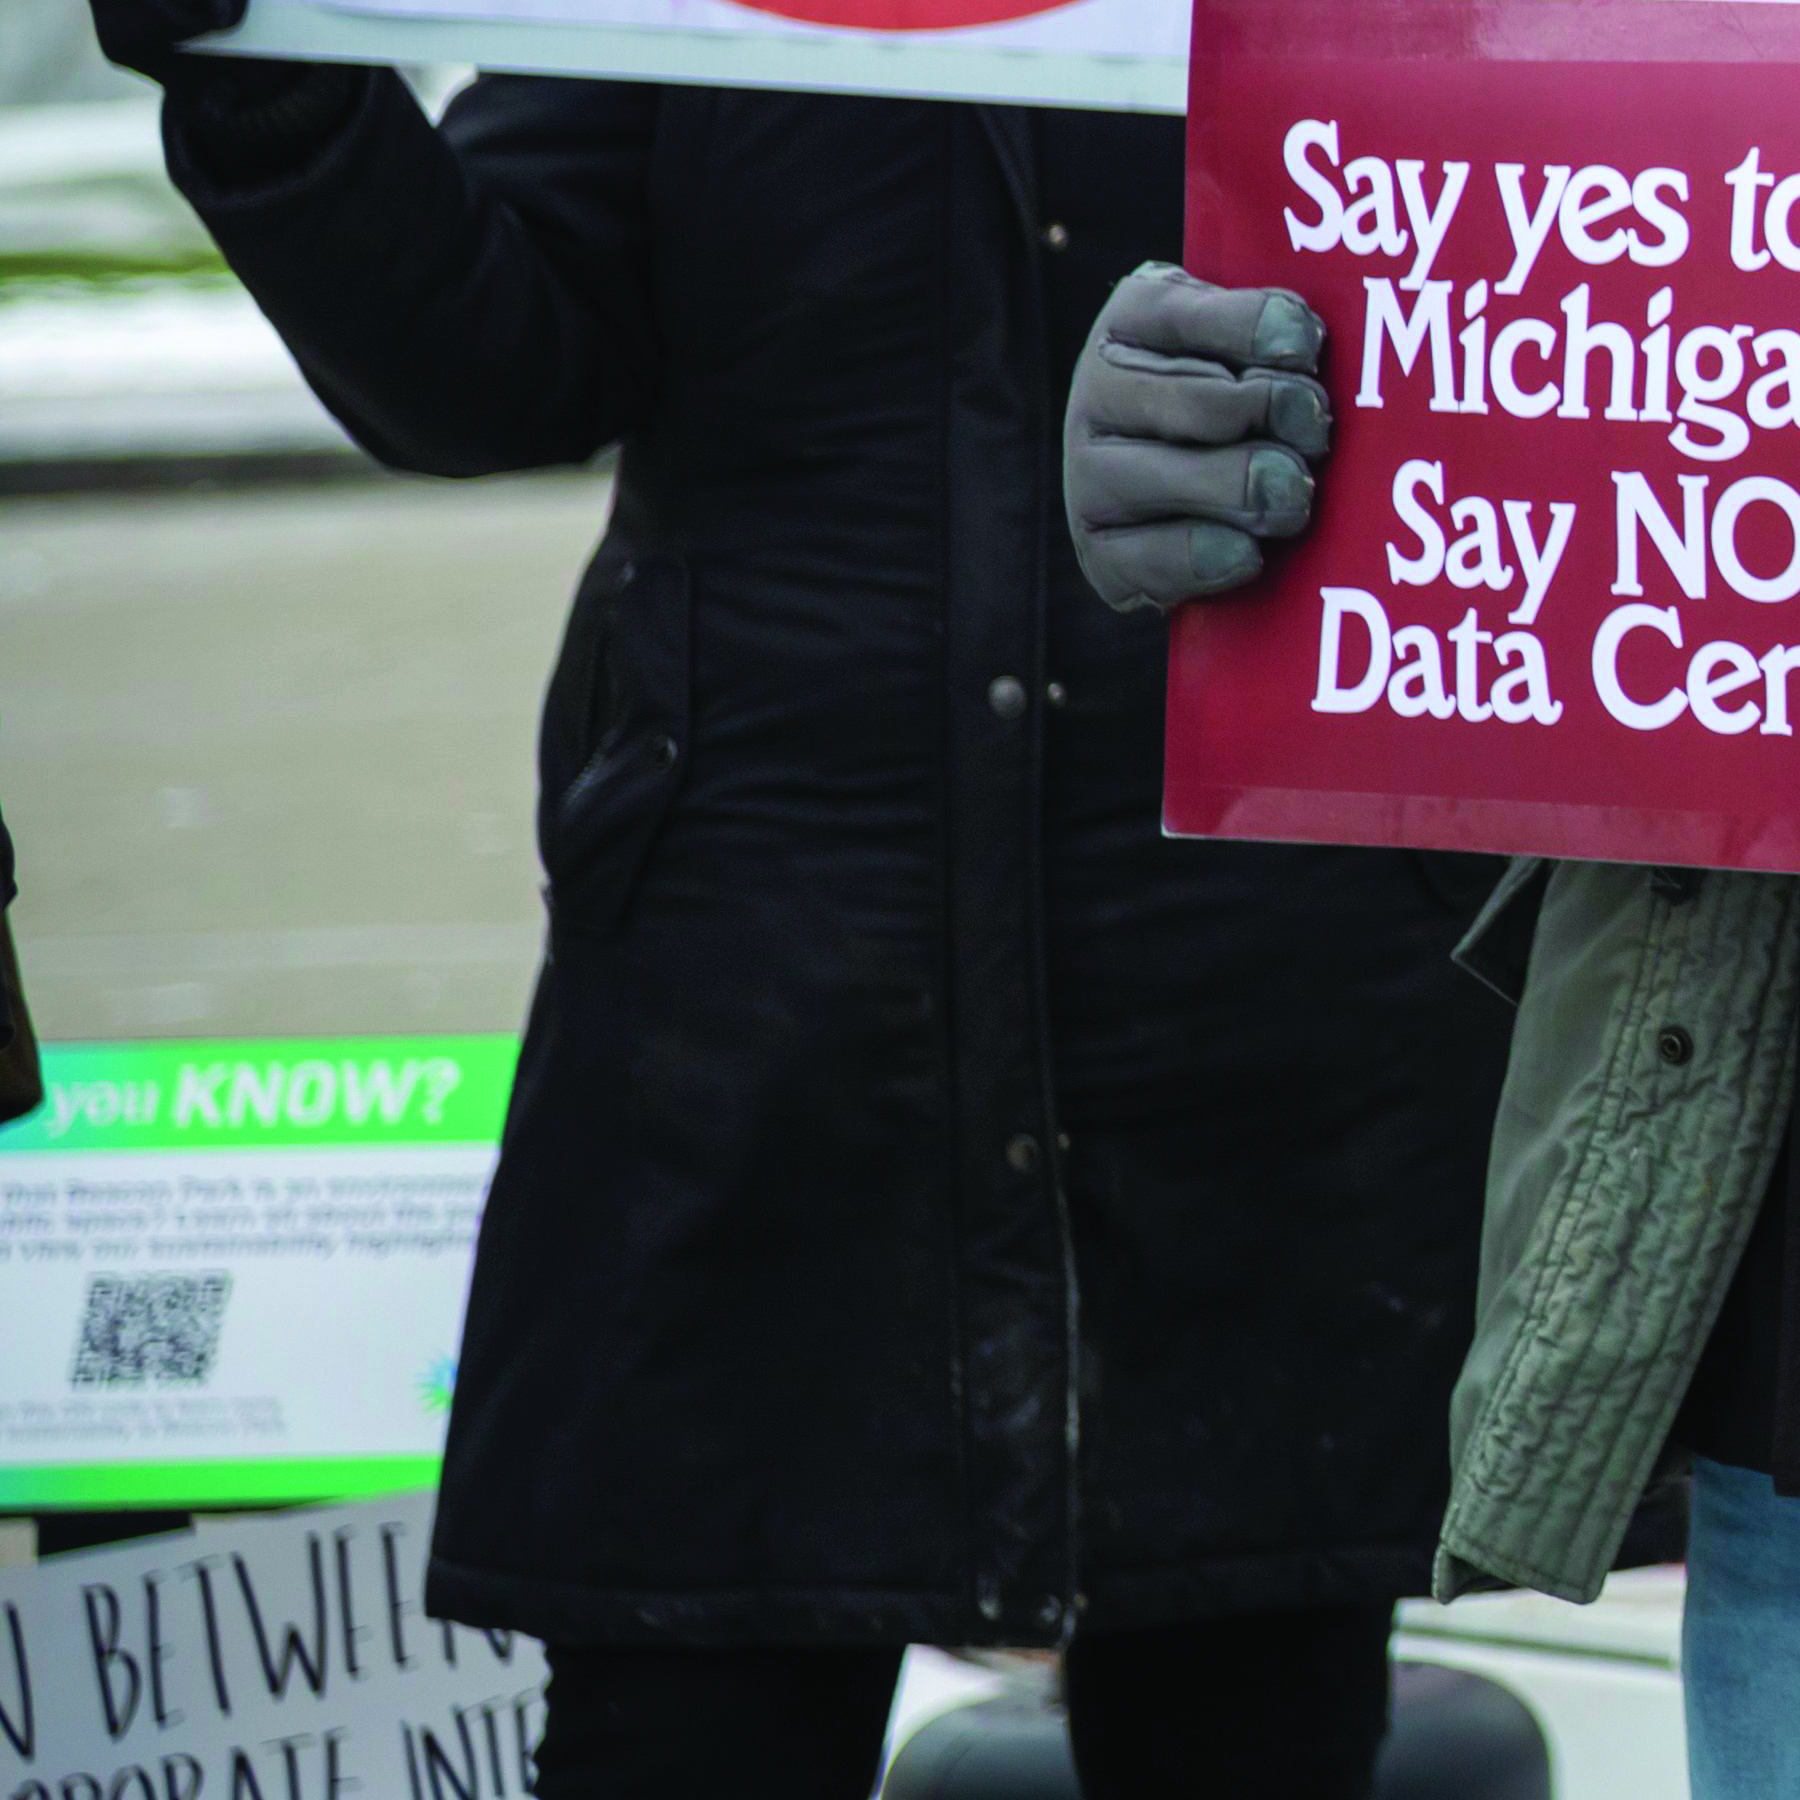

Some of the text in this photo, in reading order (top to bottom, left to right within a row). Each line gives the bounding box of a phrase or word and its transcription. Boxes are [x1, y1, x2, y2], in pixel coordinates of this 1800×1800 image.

[1283, 119, 1470, 291] Say
[1494, 162, 1690, 295] yes
[1386, 459, 1577, 624] Say
[1311, 586, 1563, 726] Data
[46, 1058, 460, 1138] you KNOW?
[81, 1520, 516, 1745] BETWEE
